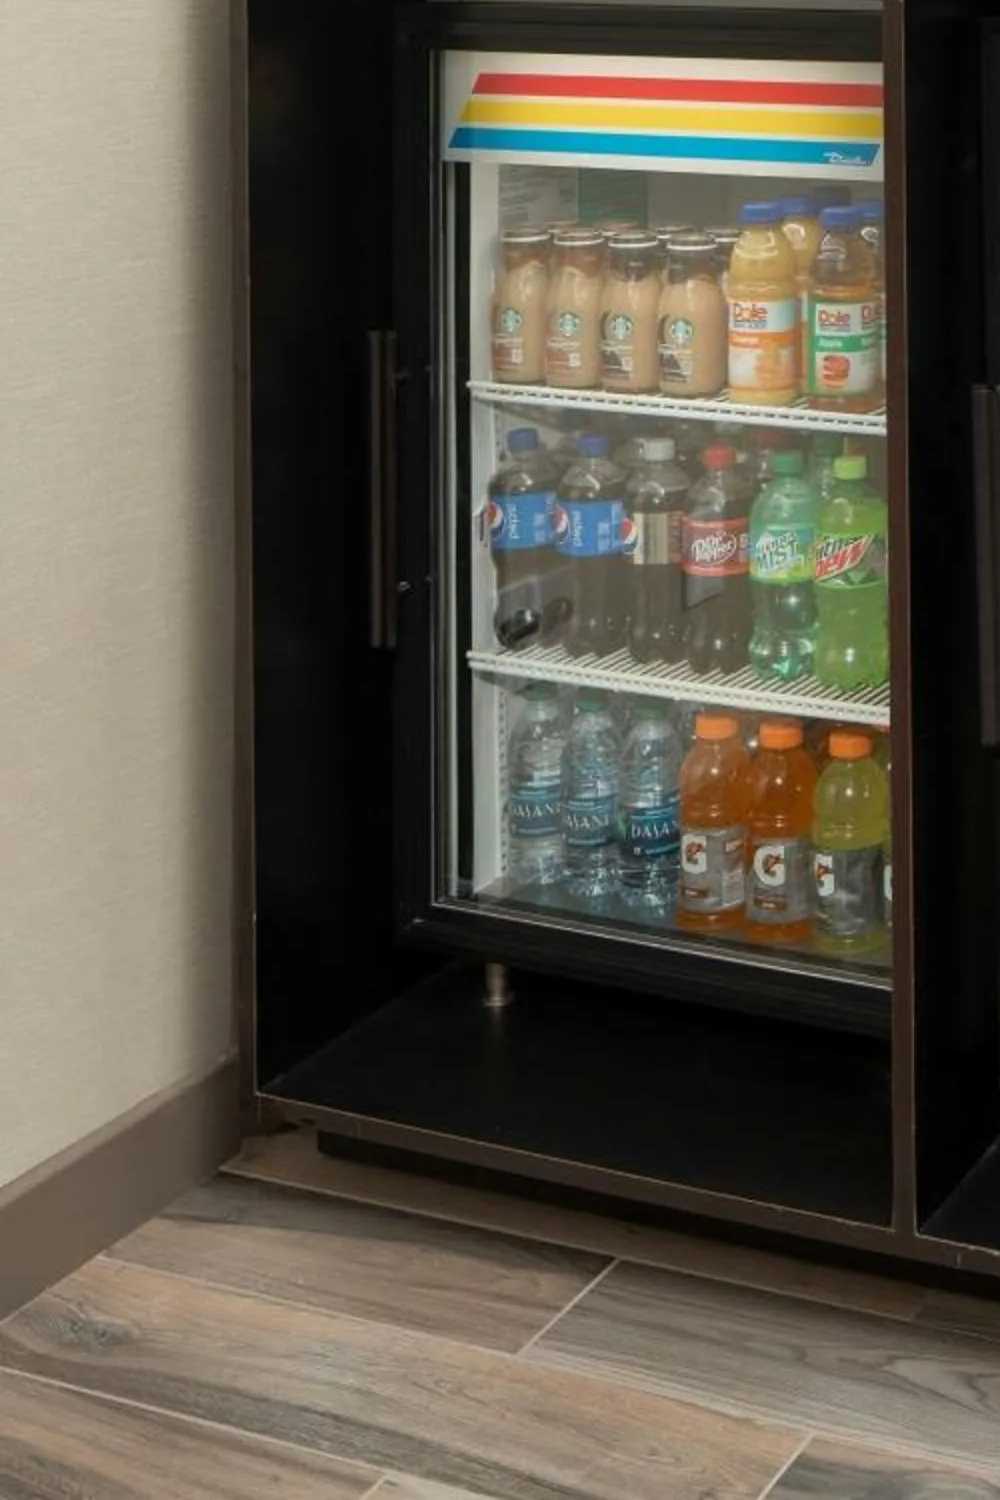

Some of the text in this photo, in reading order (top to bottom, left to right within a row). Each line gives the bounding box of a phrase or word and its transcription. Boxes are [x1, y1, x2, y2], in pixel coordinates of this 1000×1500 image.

[733, 303, 768, 321] Dole
[681, 834, 707, 874] G
[753, 845, 786, 887] G
